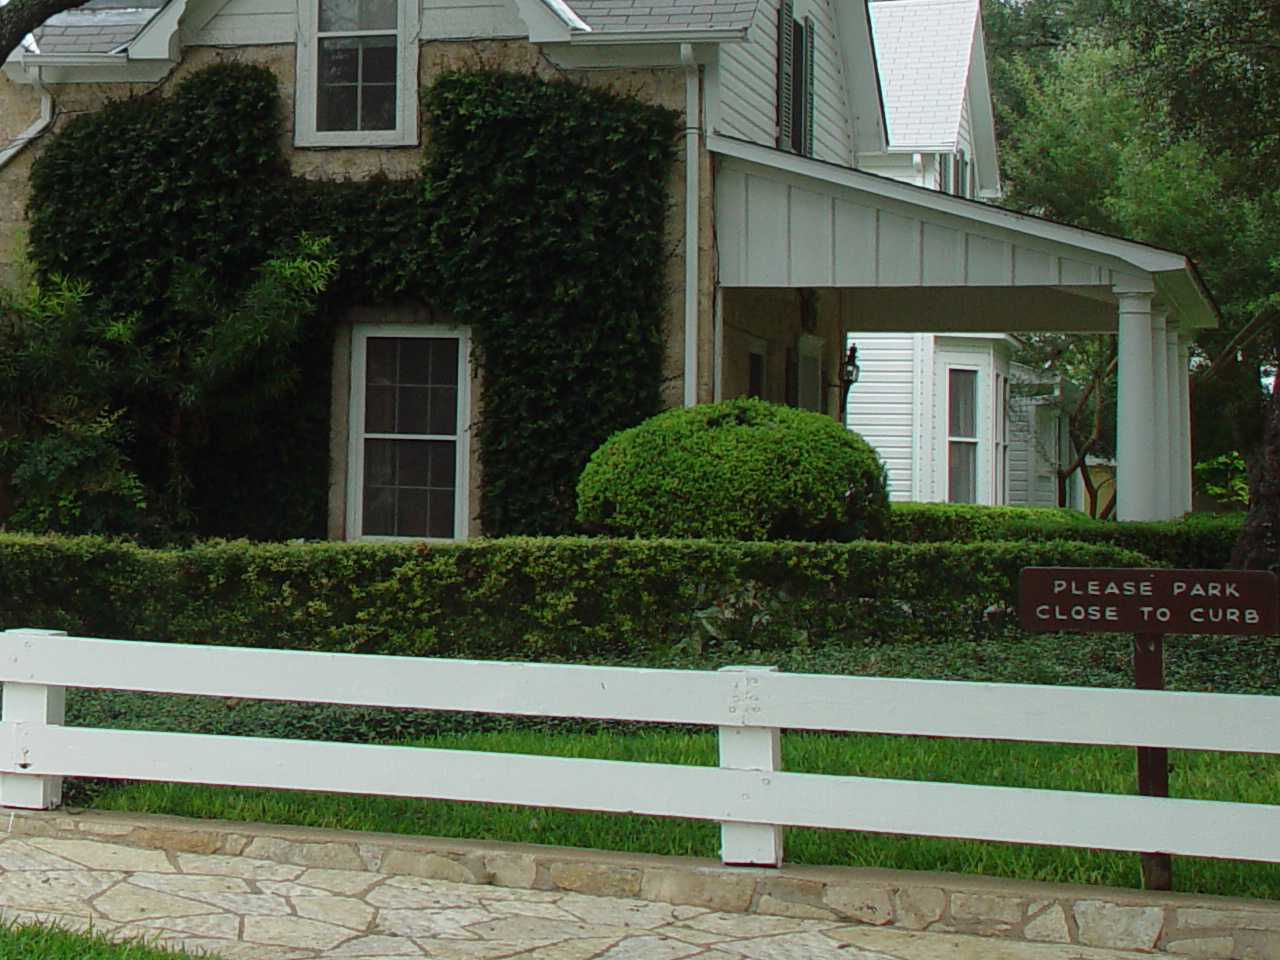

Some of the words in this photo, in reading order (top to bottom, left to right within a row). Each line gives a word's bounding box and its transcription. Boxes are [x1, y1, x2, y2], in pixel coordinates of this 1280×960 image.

[1053, 580, 1153, 596] PLEASE
[1173, 582, 1240, 597] PARK
[1035, 605, 1119, 621] CLOSE
[1140, 606, 1171, 622] TO
[1190, 608, 1260, 624] CURB
